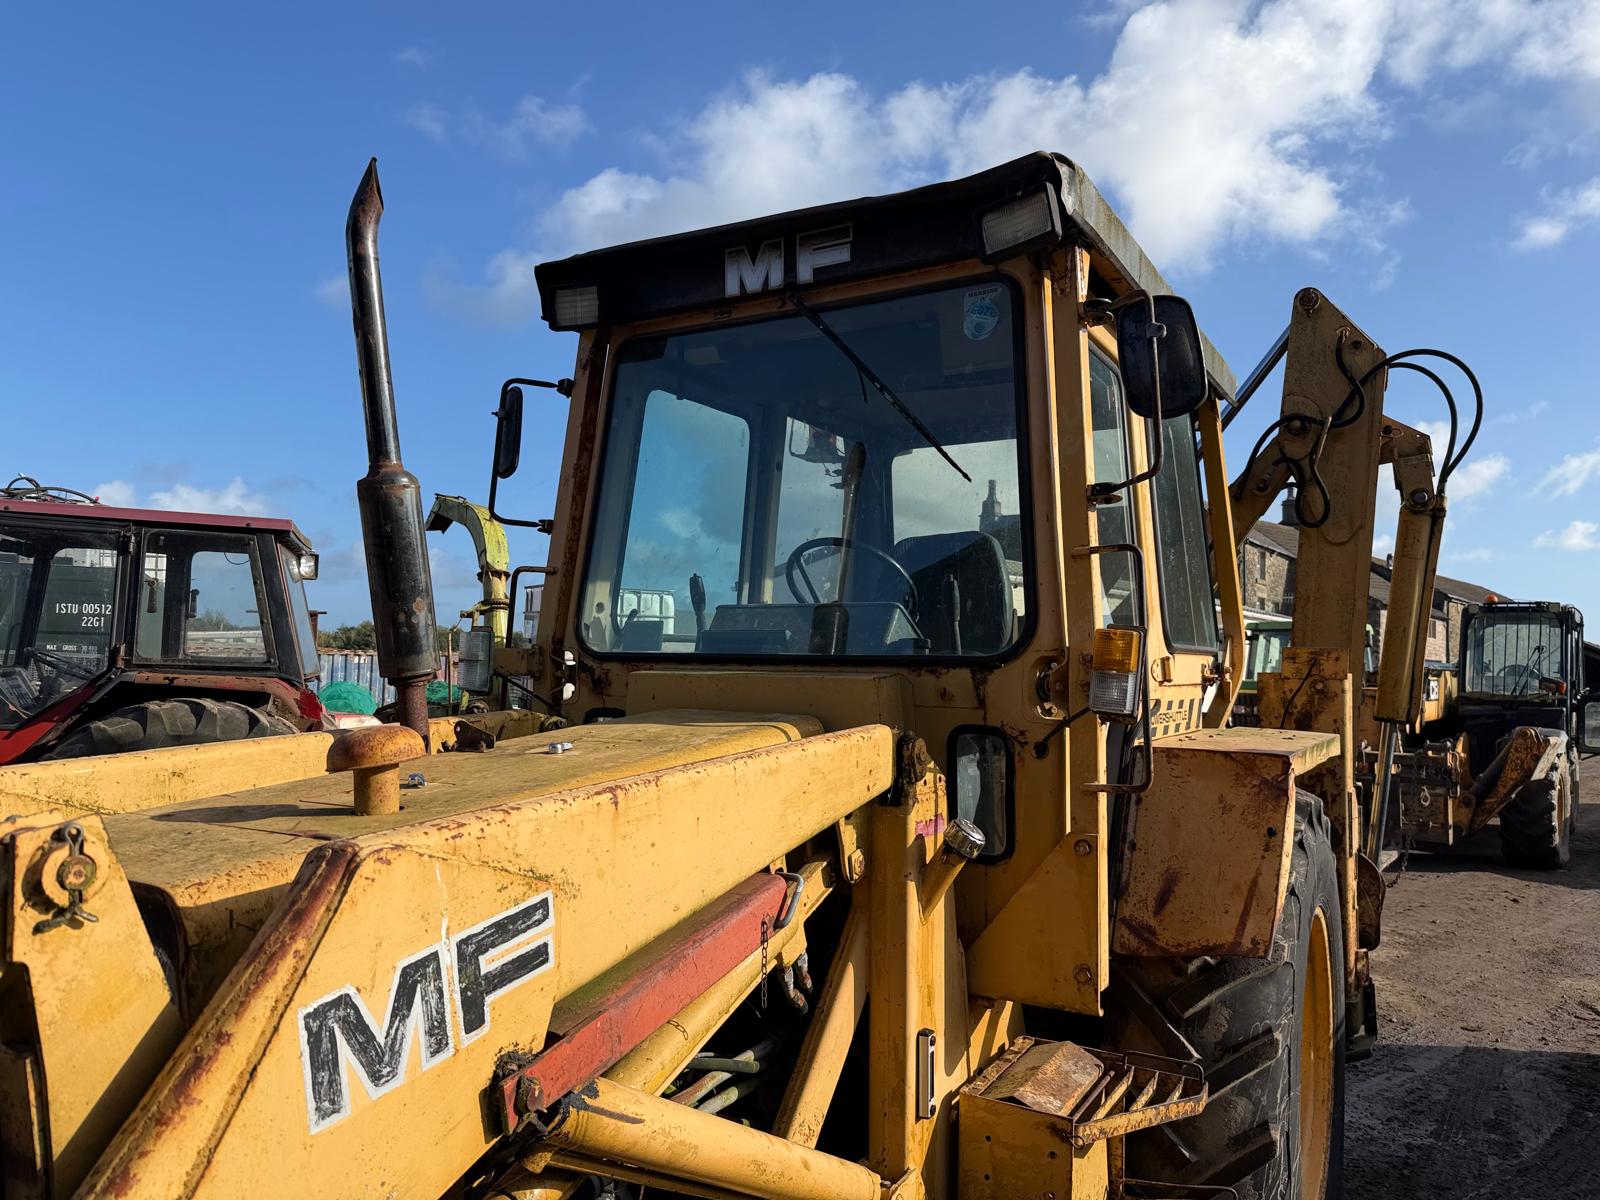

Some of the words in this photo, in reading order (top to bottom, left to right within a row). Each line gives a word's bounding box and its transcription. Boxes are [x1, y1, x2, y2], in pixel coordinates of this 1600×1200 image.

[725, 222, 853, 298] MF
[82, 603, 112, 615] 00512
[81, 616, 104, 627] 22G1
[1151, 709, 1188, 725] OWERSHUTTLE
[297, 889, 556, 1135] MF
